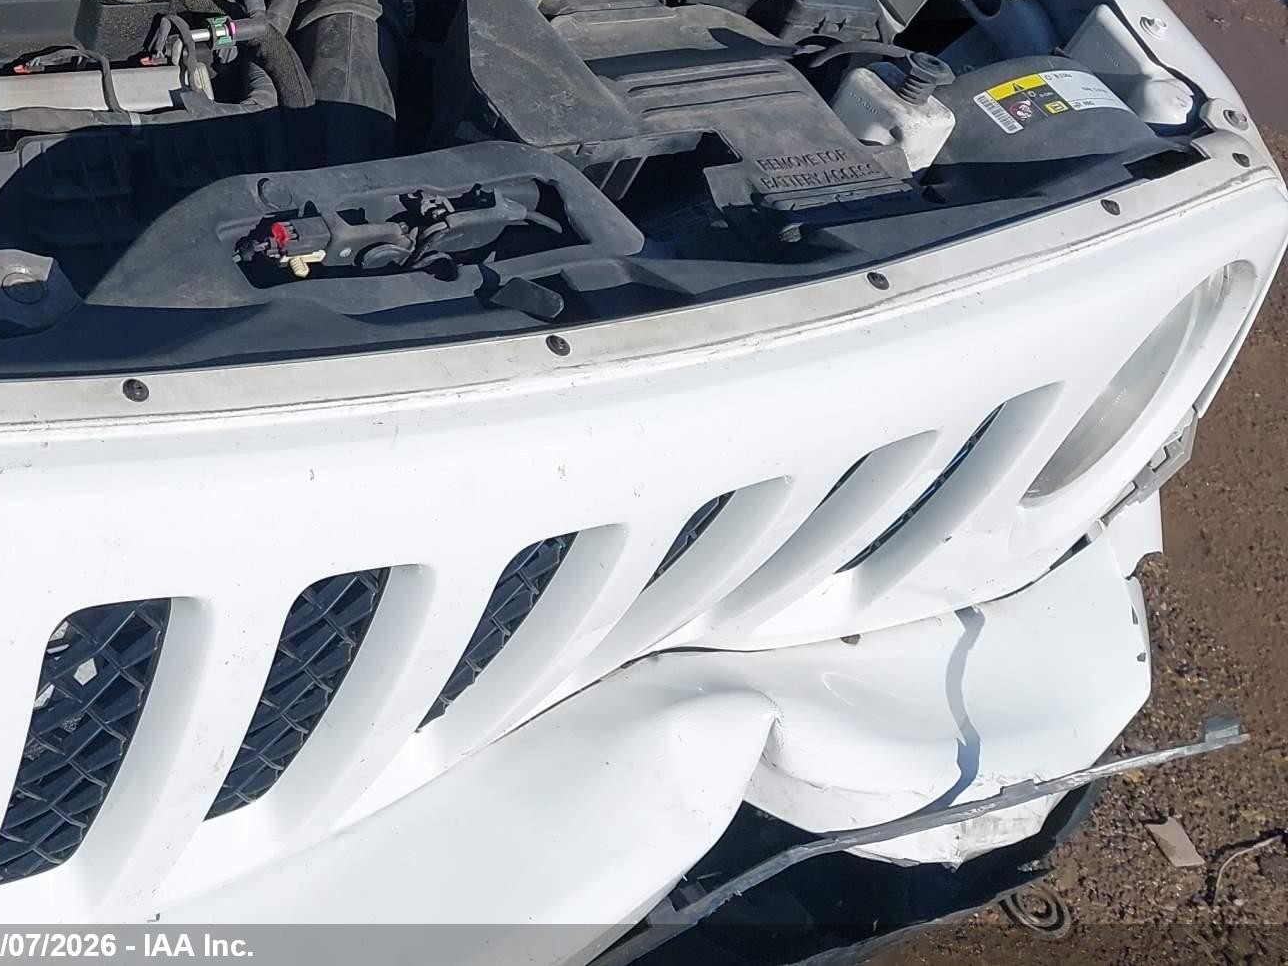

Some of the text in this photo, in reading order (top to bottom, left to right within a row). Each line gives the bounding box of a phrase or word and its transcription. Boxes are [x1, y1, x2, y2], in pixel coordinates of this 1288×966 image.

[756, 148, 846, 172] REMOVE FOR
[760, 172, 822, 190] BATTERY
